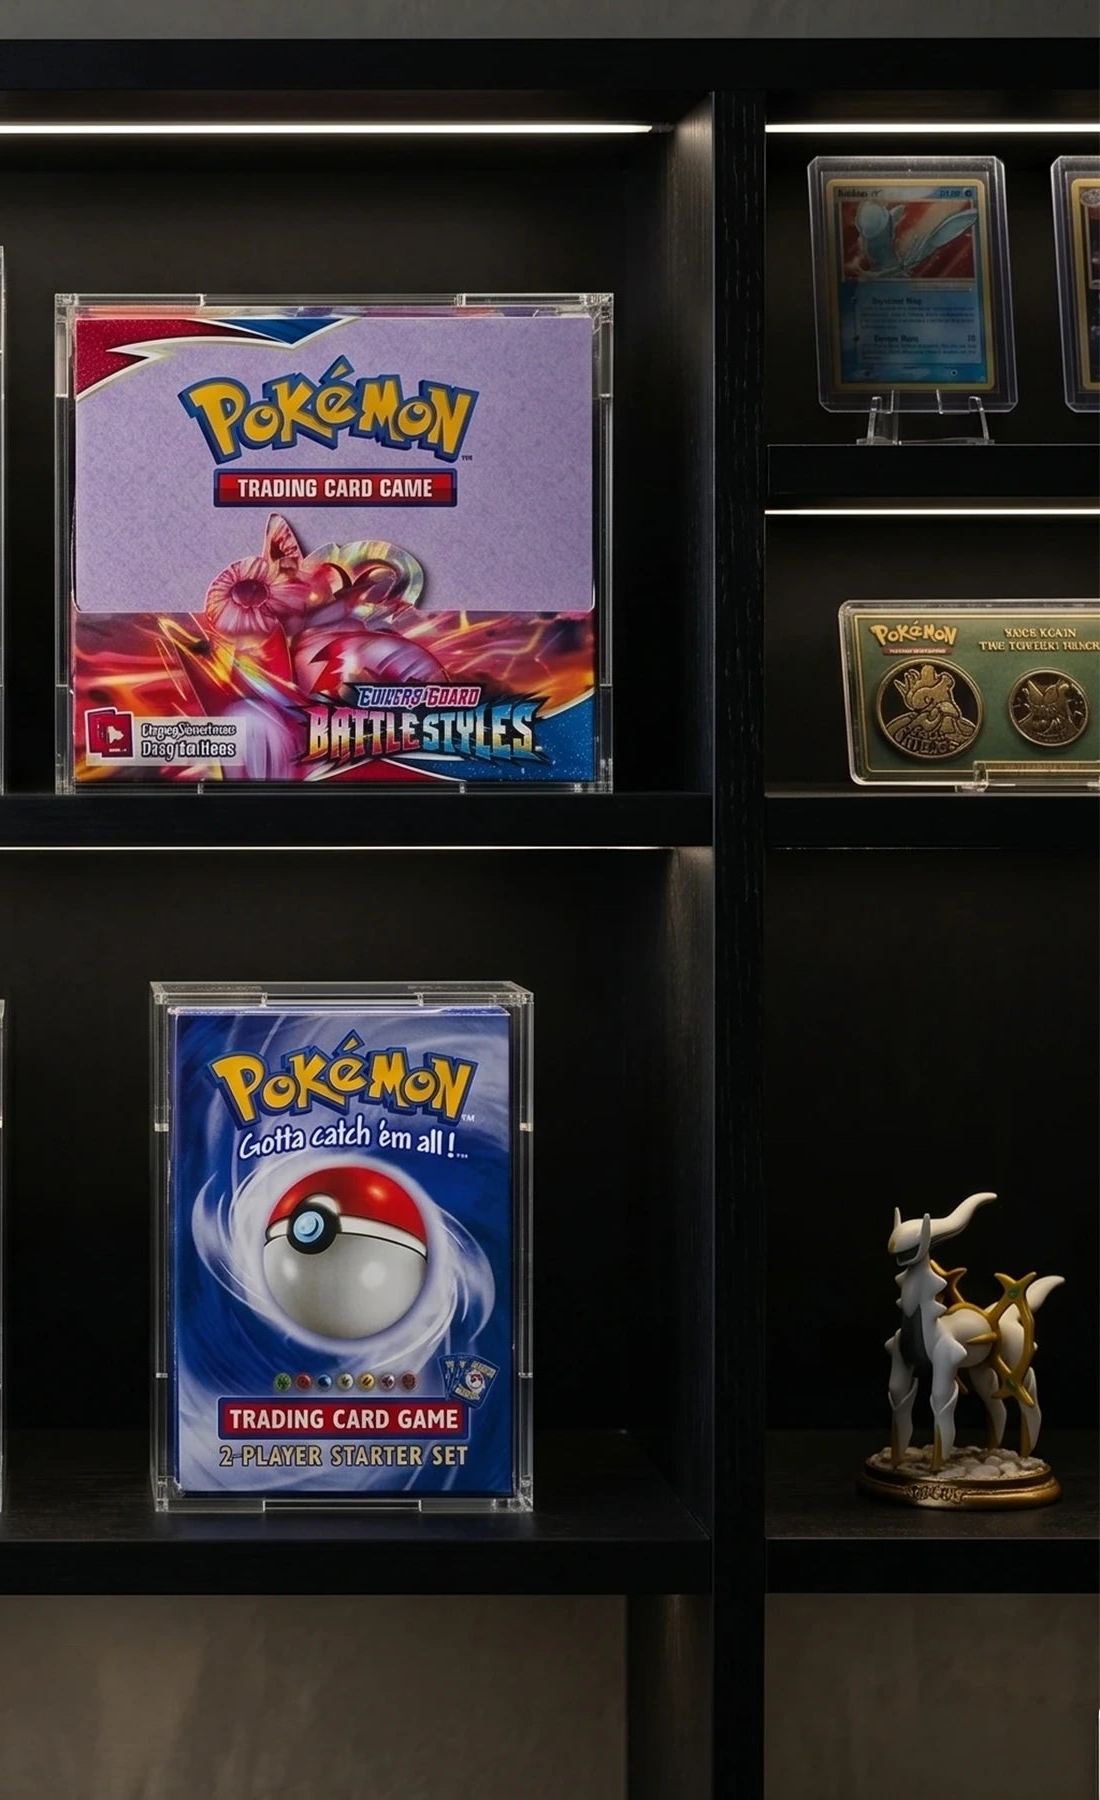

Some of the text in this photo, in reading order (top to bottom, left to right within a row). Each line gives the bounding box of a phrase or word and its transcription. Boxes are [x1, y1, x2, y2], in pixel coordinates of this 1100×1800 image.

[238, 479, 317, 497] TRADING
[325, 479, 372, 497] CARD
[239, 1126, 304, 1158] Gotta
[311, 1115, 370, 1145] catch
[416, 1129, 443, 1154] all
[230, 1410, 458, 1428] TRADING CARD GAME
[331, 1446, 423, 1466] STARTER
[433, 1446, 468, 1466] SET
